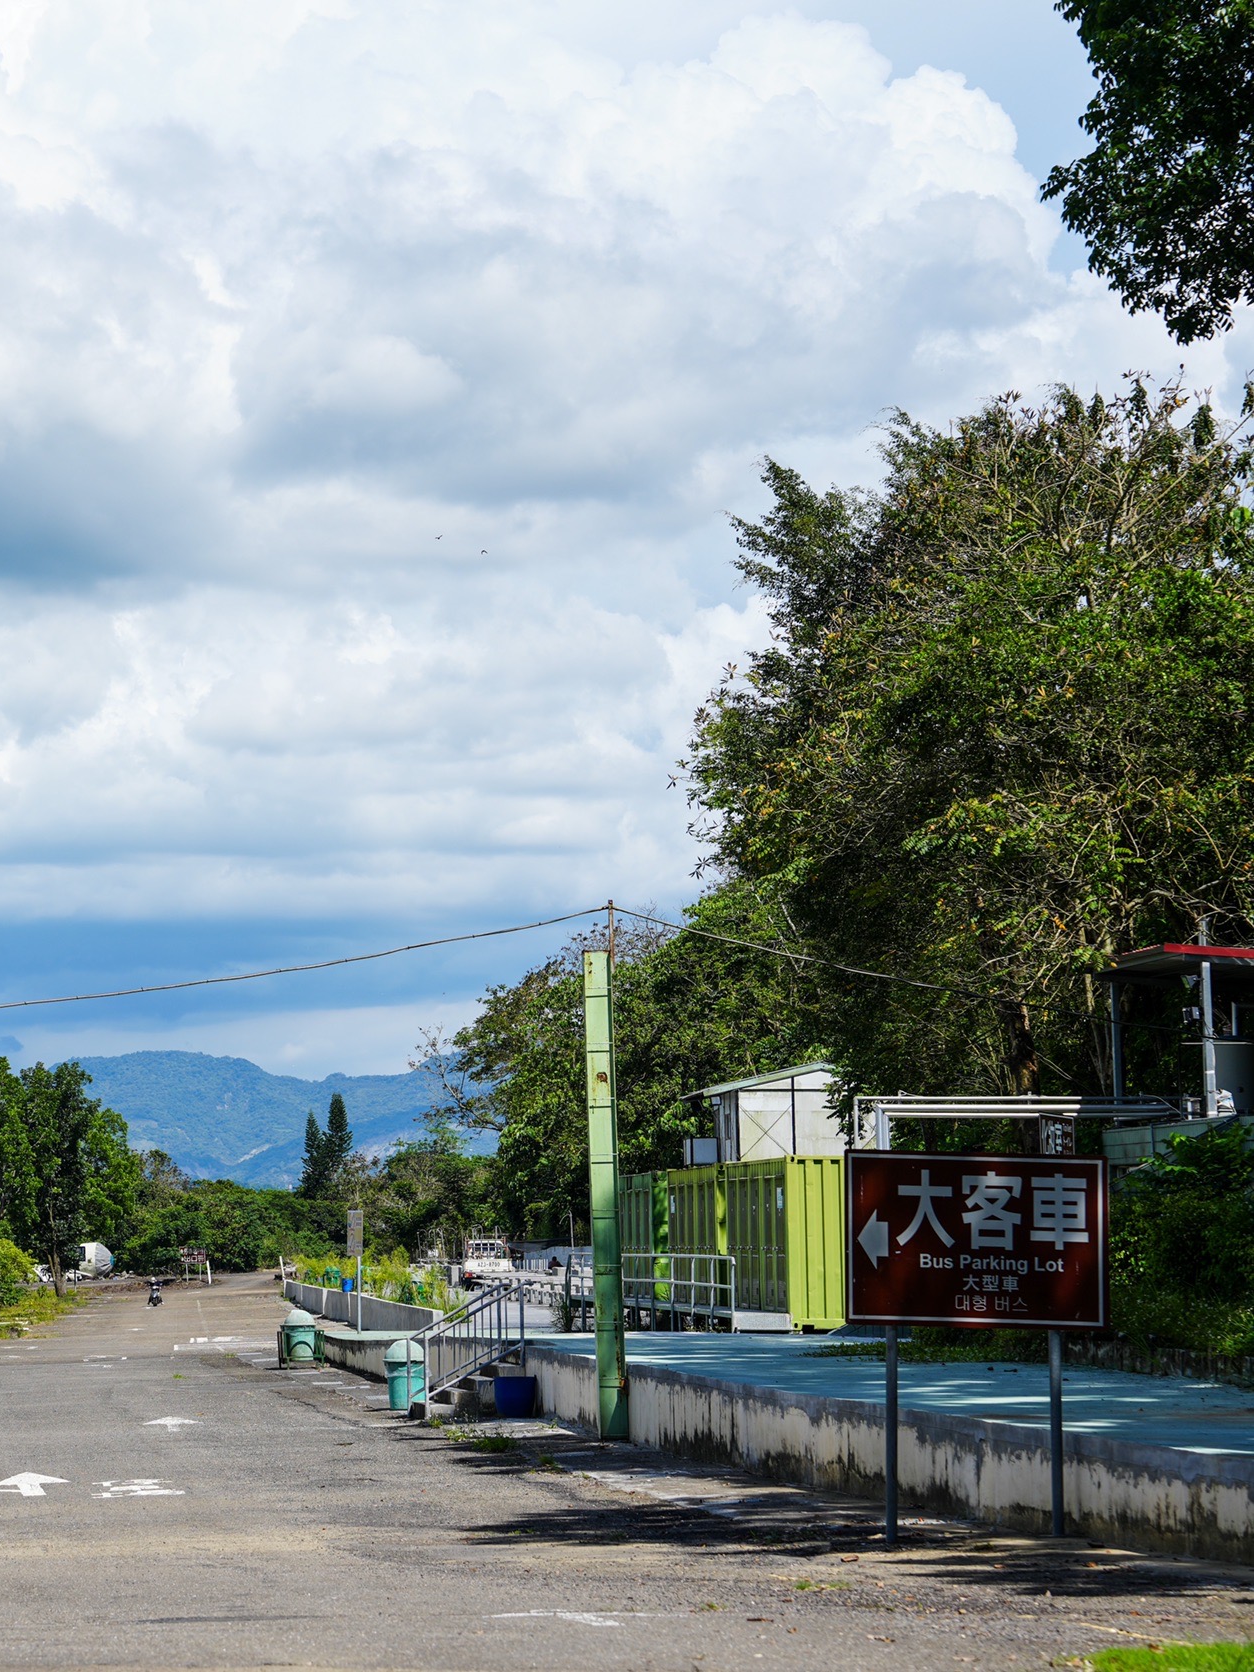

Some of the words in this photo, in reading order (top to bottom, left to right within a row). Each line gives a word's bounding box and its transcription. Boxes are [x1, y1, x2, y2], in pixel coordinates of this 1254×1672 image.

[896, 1169, 1090, 1251] 大客車
[919, 1253, 954, 1269] Bus
[959, 1254, 1029, 1273] Parking
[1034, 1256, 1065, 1272] Lot
[962, 1274, 1020, 1292] 大型車
[954, 1294, 988, 1312] 대형
[994, 1295, 1029, 1312] 버스
